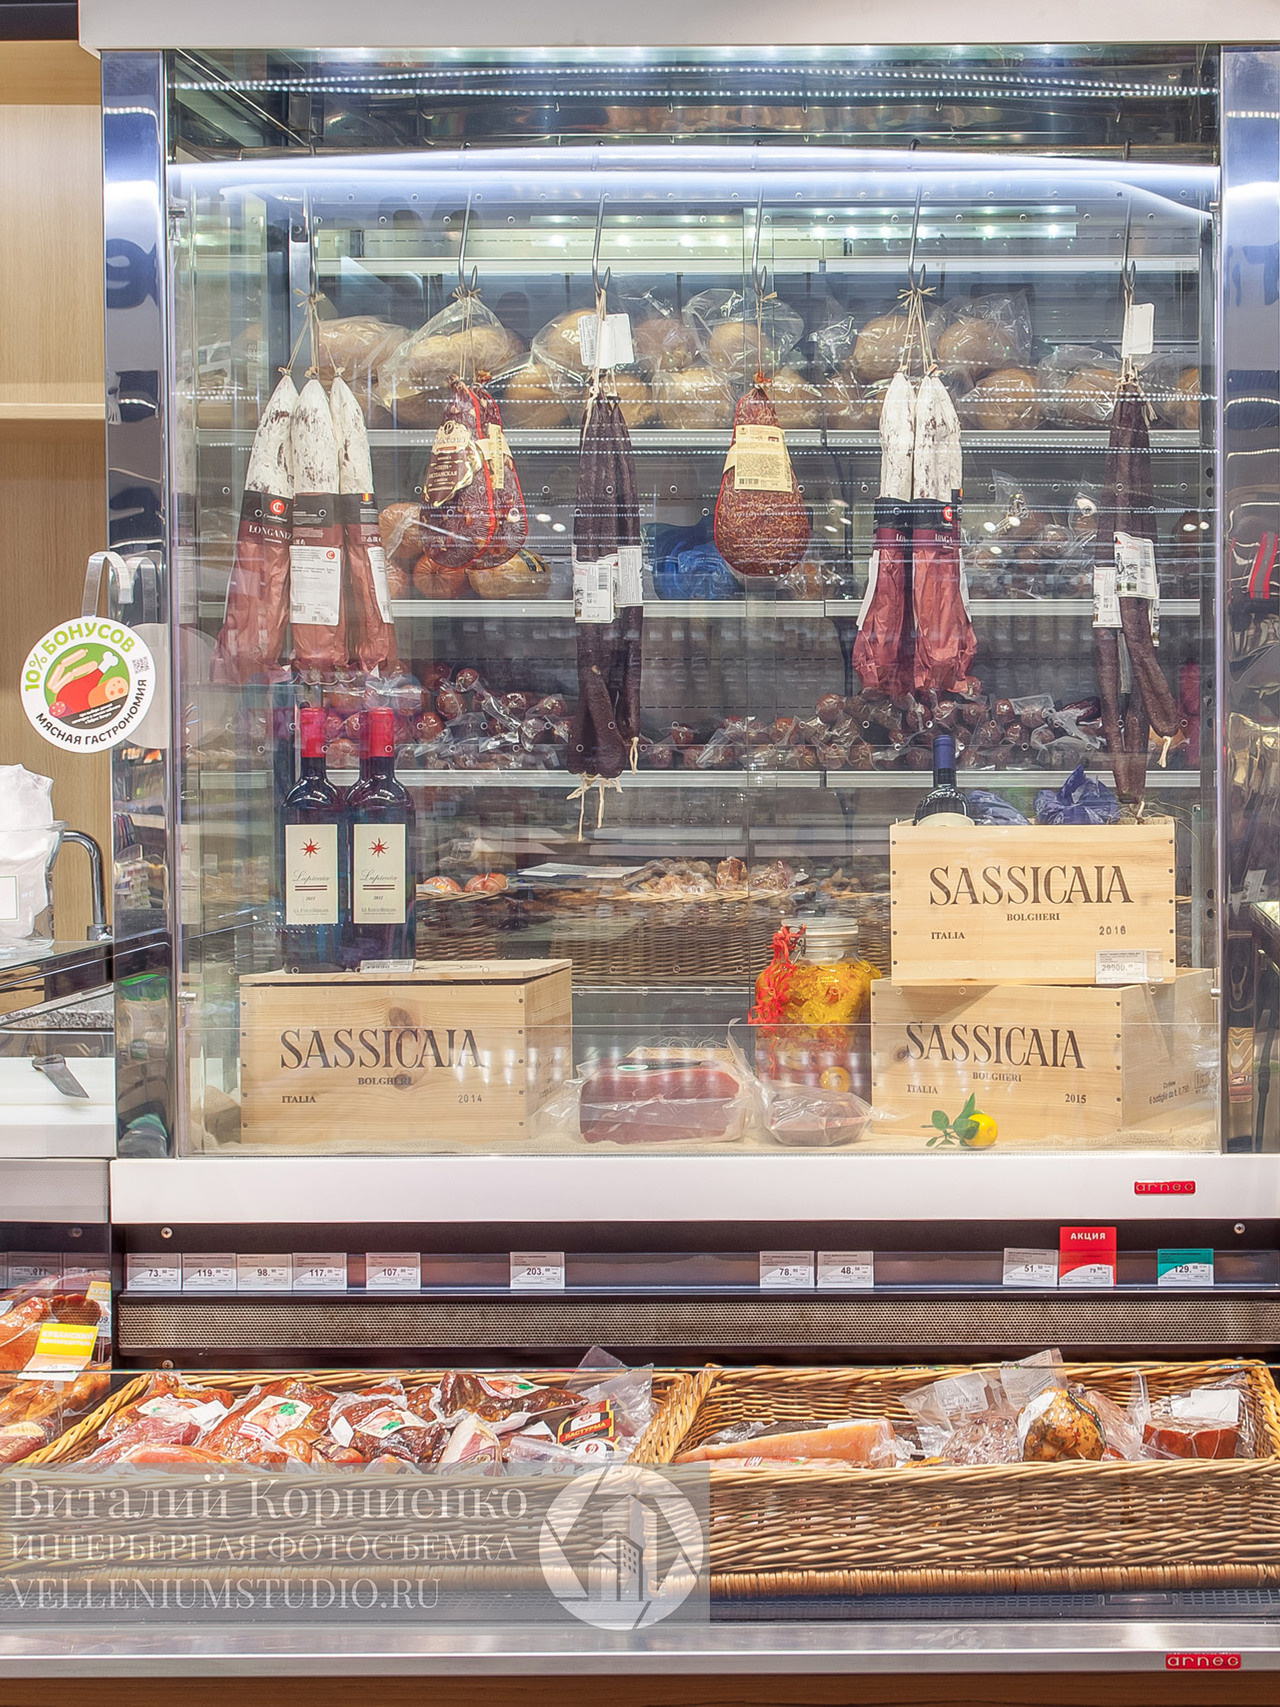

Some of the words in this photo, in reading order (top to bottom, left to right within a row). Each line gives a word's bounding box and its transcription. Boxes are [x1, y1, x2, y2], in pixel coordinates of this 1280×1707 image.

[25, 653, 48, 692] 10%
[41, 622, 136, 655] БОНУСОВ
[35, 712, 82, 745] МЯСНАЯ
[85, 679, 148, 745] ГАСТРОНОМИЯ
[930, 865, 1135, 906] SASSICAIA
[1006, 912, 1061, 922] BOLGHERI
[931, 931, 966, 940] ITALIA
[280, 1028, 487, 1070] SASSICAIA
[905, 1020, 1086, 1069] SASSICAIA
[972, 1071, 1022, 1083] BOLGHERI
[906, 1084, 939, 1095] ITALIA
[281, 1095, 317, 1104] ITALIA
[458, 1093, 483, 1104] 2014
[1064, 1093, 1087, 1104] 2015
[1070, 1231, 1106, 1241] АКЦИЯ
